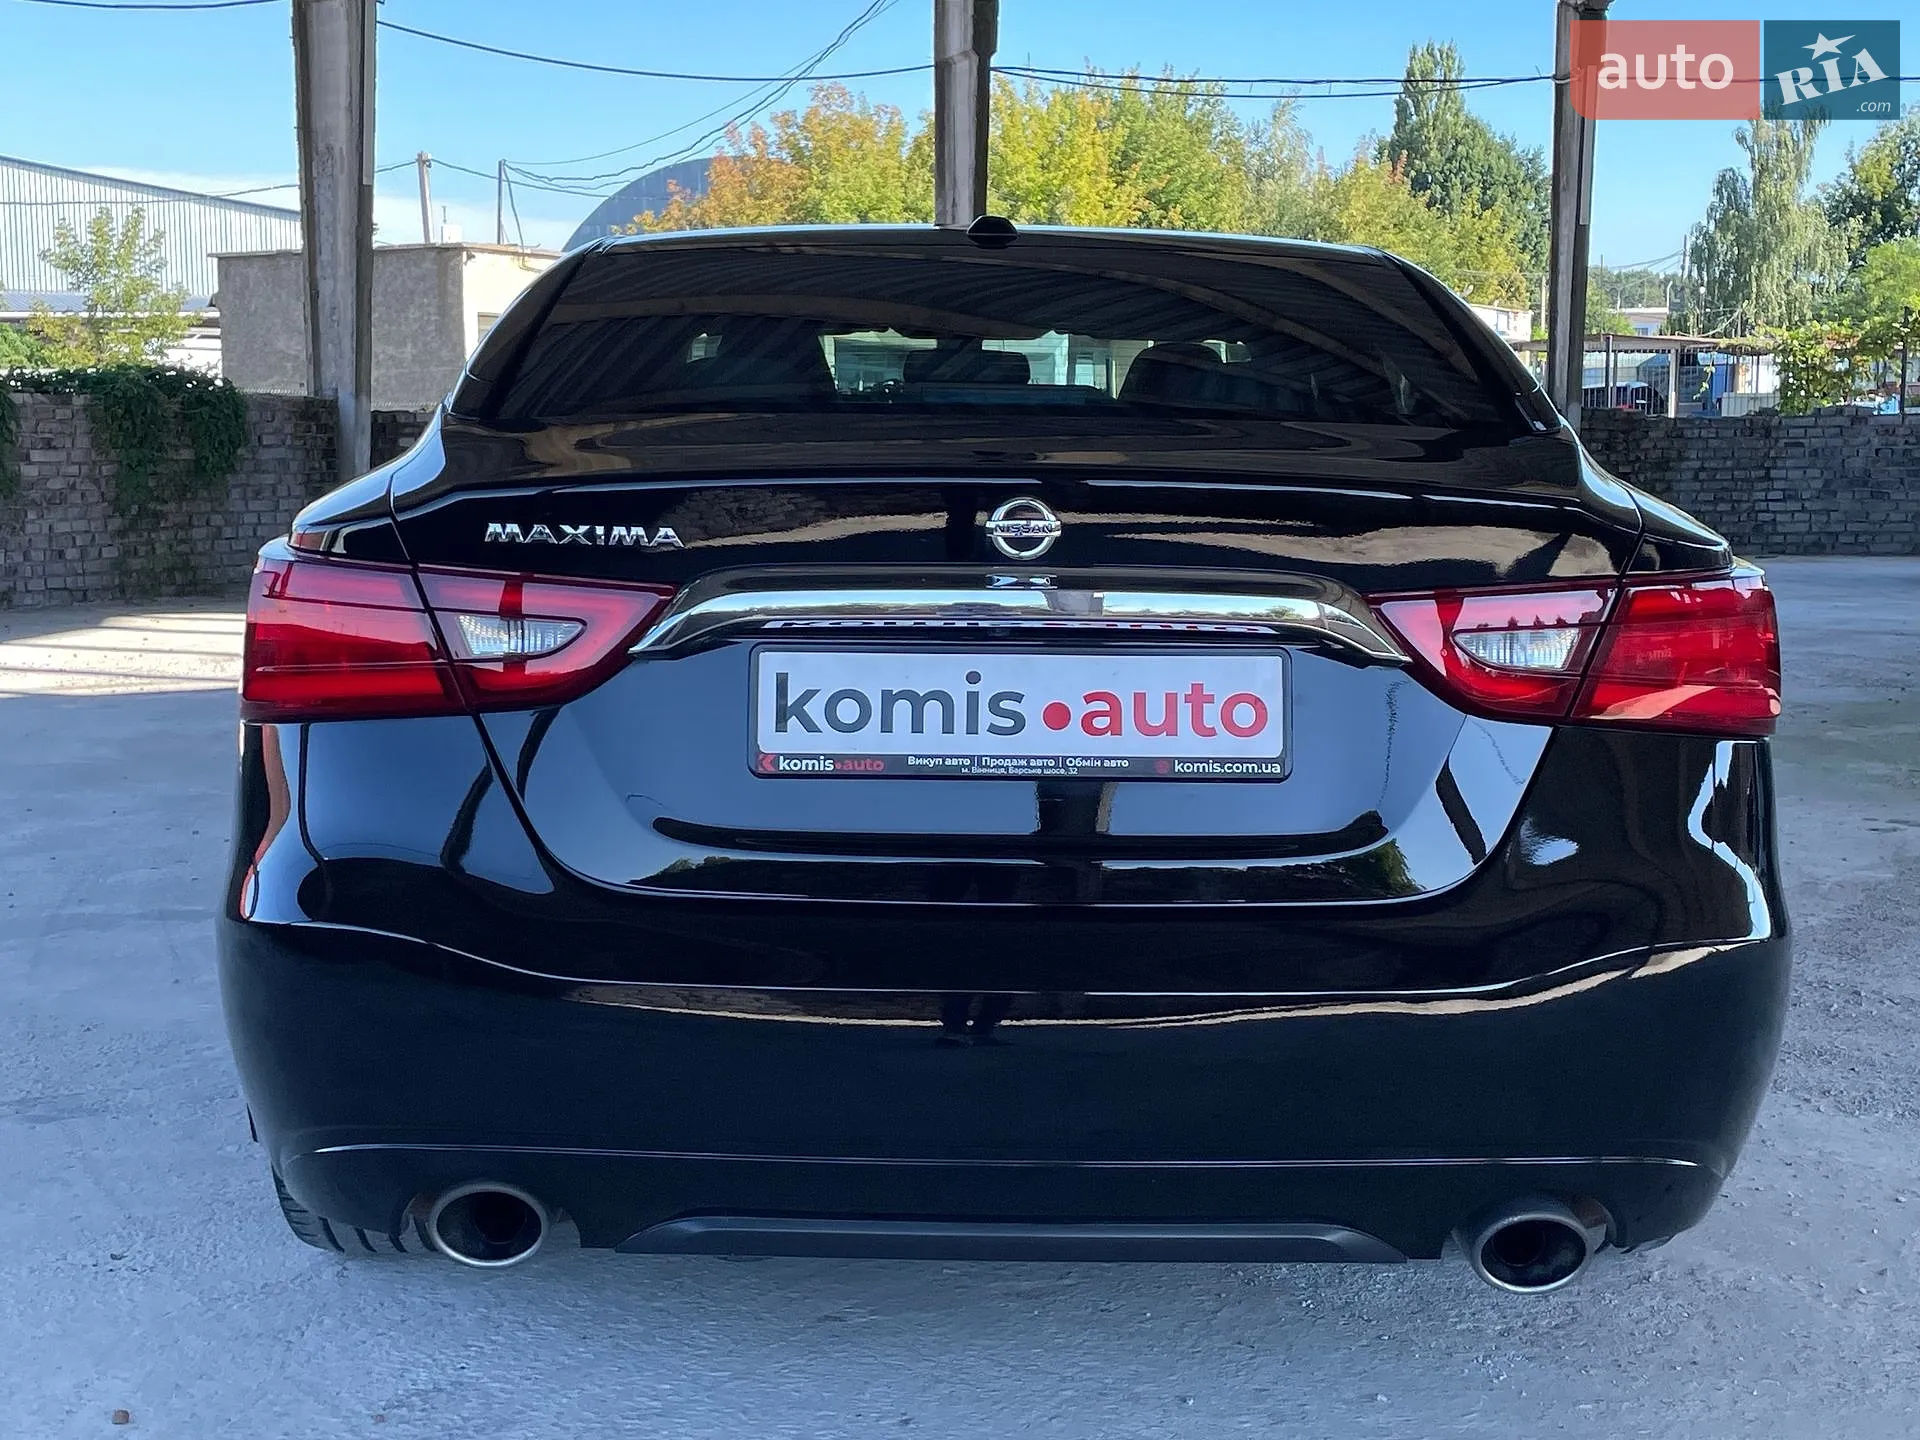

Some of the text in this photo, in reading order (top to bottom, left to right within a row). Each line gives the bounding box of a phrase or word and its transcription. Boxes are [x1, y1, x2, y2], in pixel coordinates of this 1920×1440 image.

[994, 523, 1054, 534] NISSAN
[484, 522, 685, 549] MAXIMA
[907, 756, 1129, 768] Викуп авто Продаж авто Обмін авто
[1174, 759, 1281, 774] komis.com.ua
